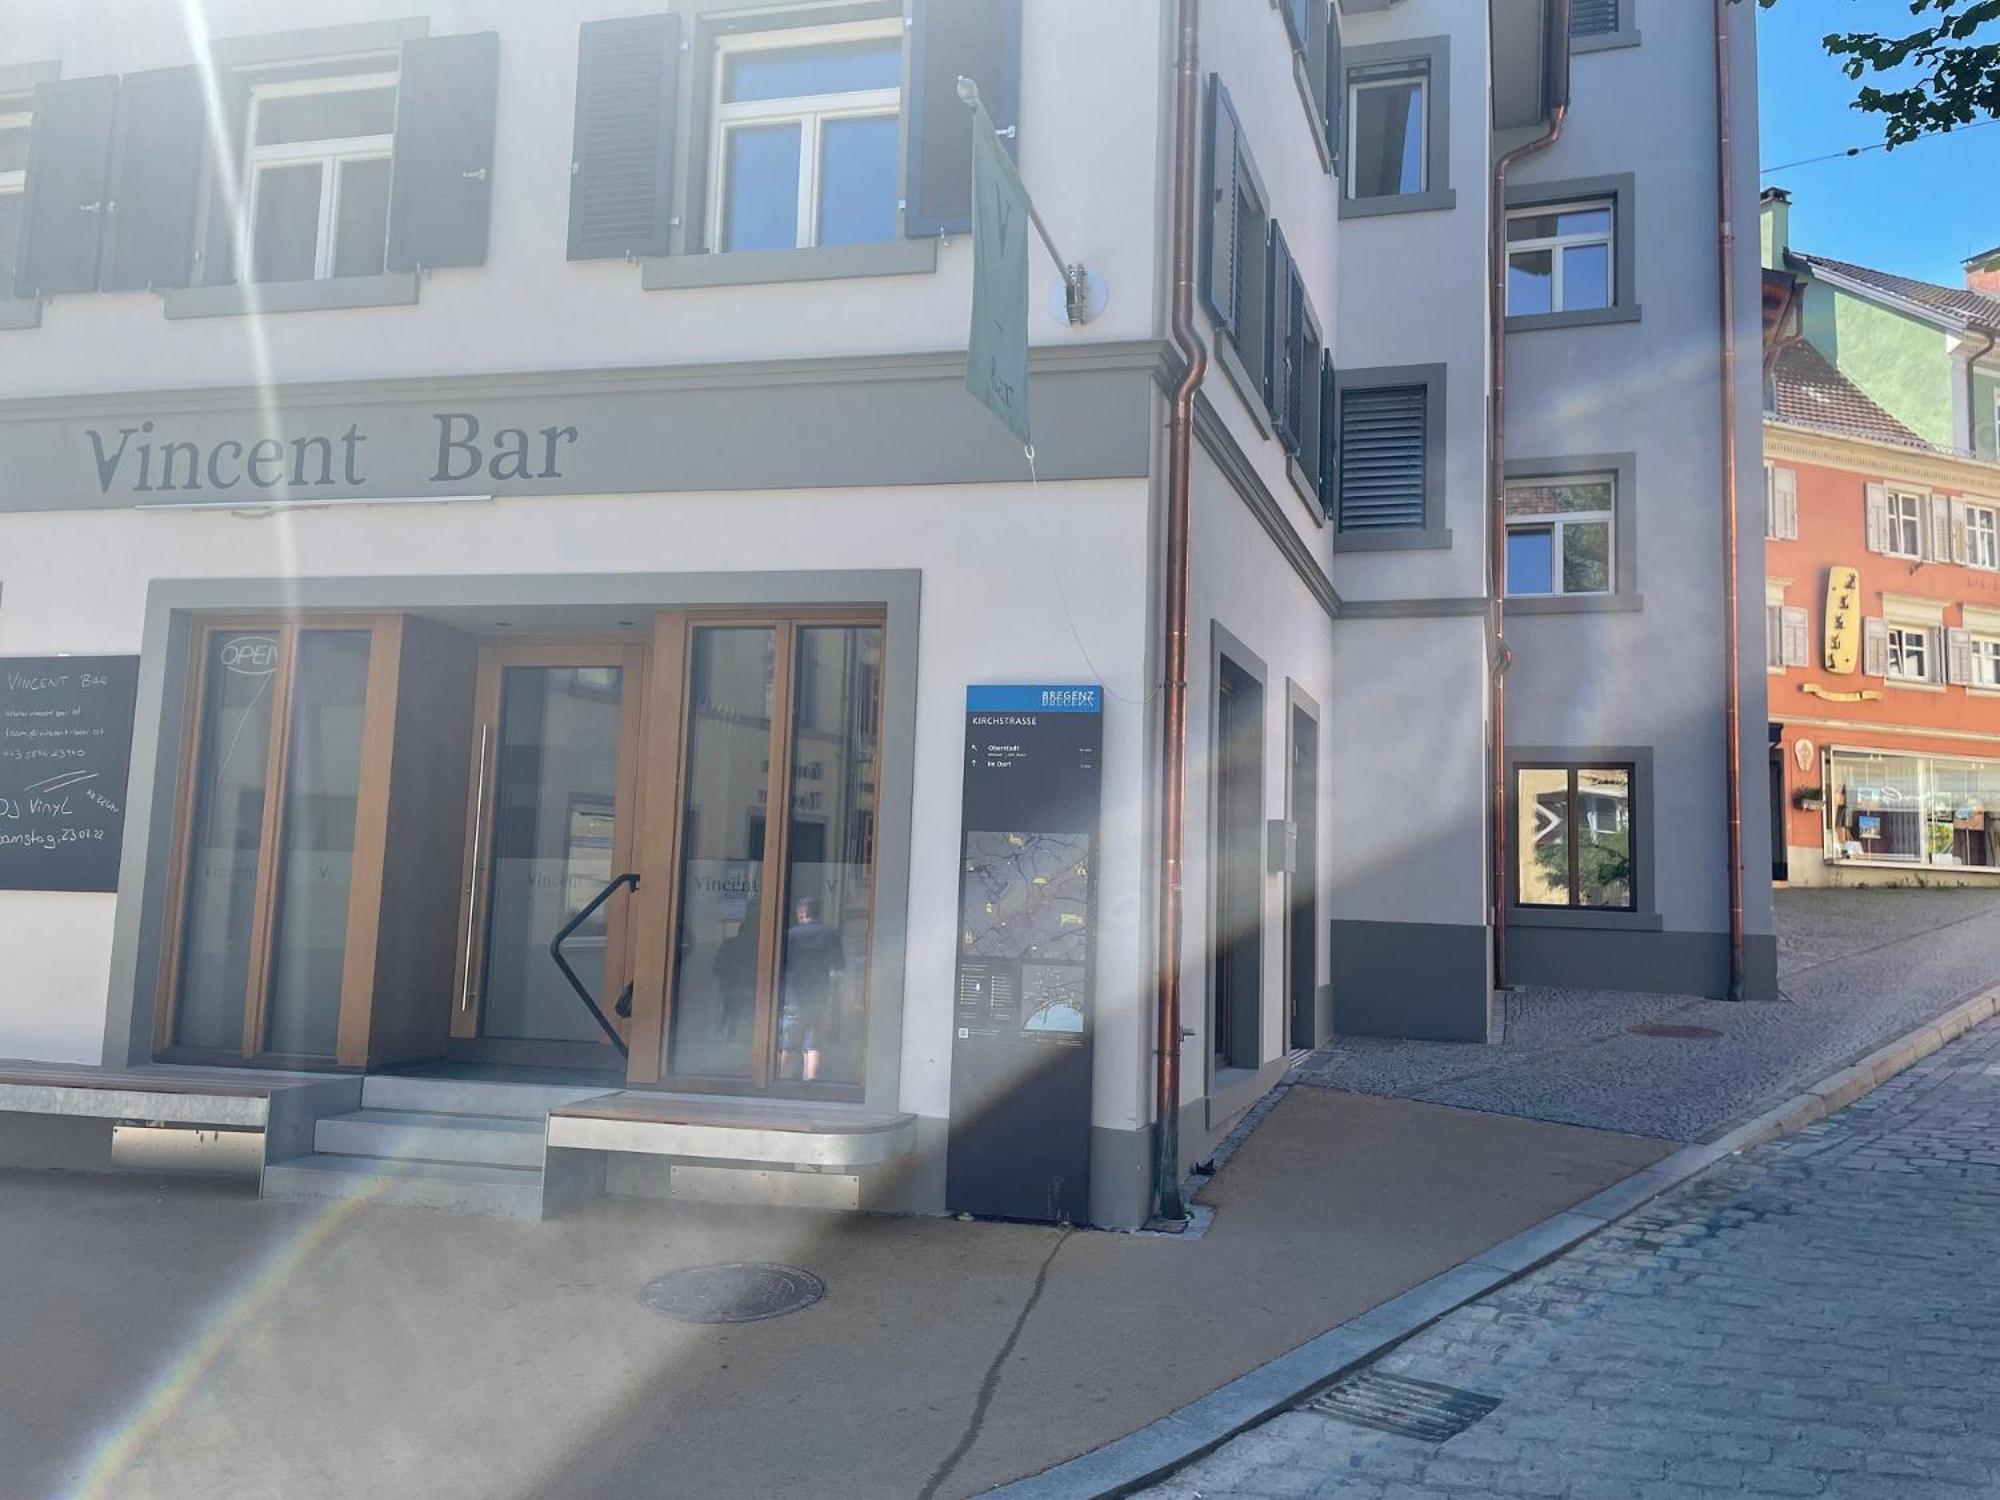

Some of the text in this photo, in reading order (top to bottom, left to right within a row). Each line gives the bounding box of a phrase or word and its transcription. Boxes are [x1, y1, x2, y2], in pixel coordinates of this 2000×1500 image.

[85, 411, 579, 495] Vincent Bar
[1041, 690, 1094, 706] BREGENZ
[972, 716, 1037, 726] KIRCHSTRASSE
[987, 744, 1020, 752] Oberstadt
[692, 872, 759, 893] Vincent
